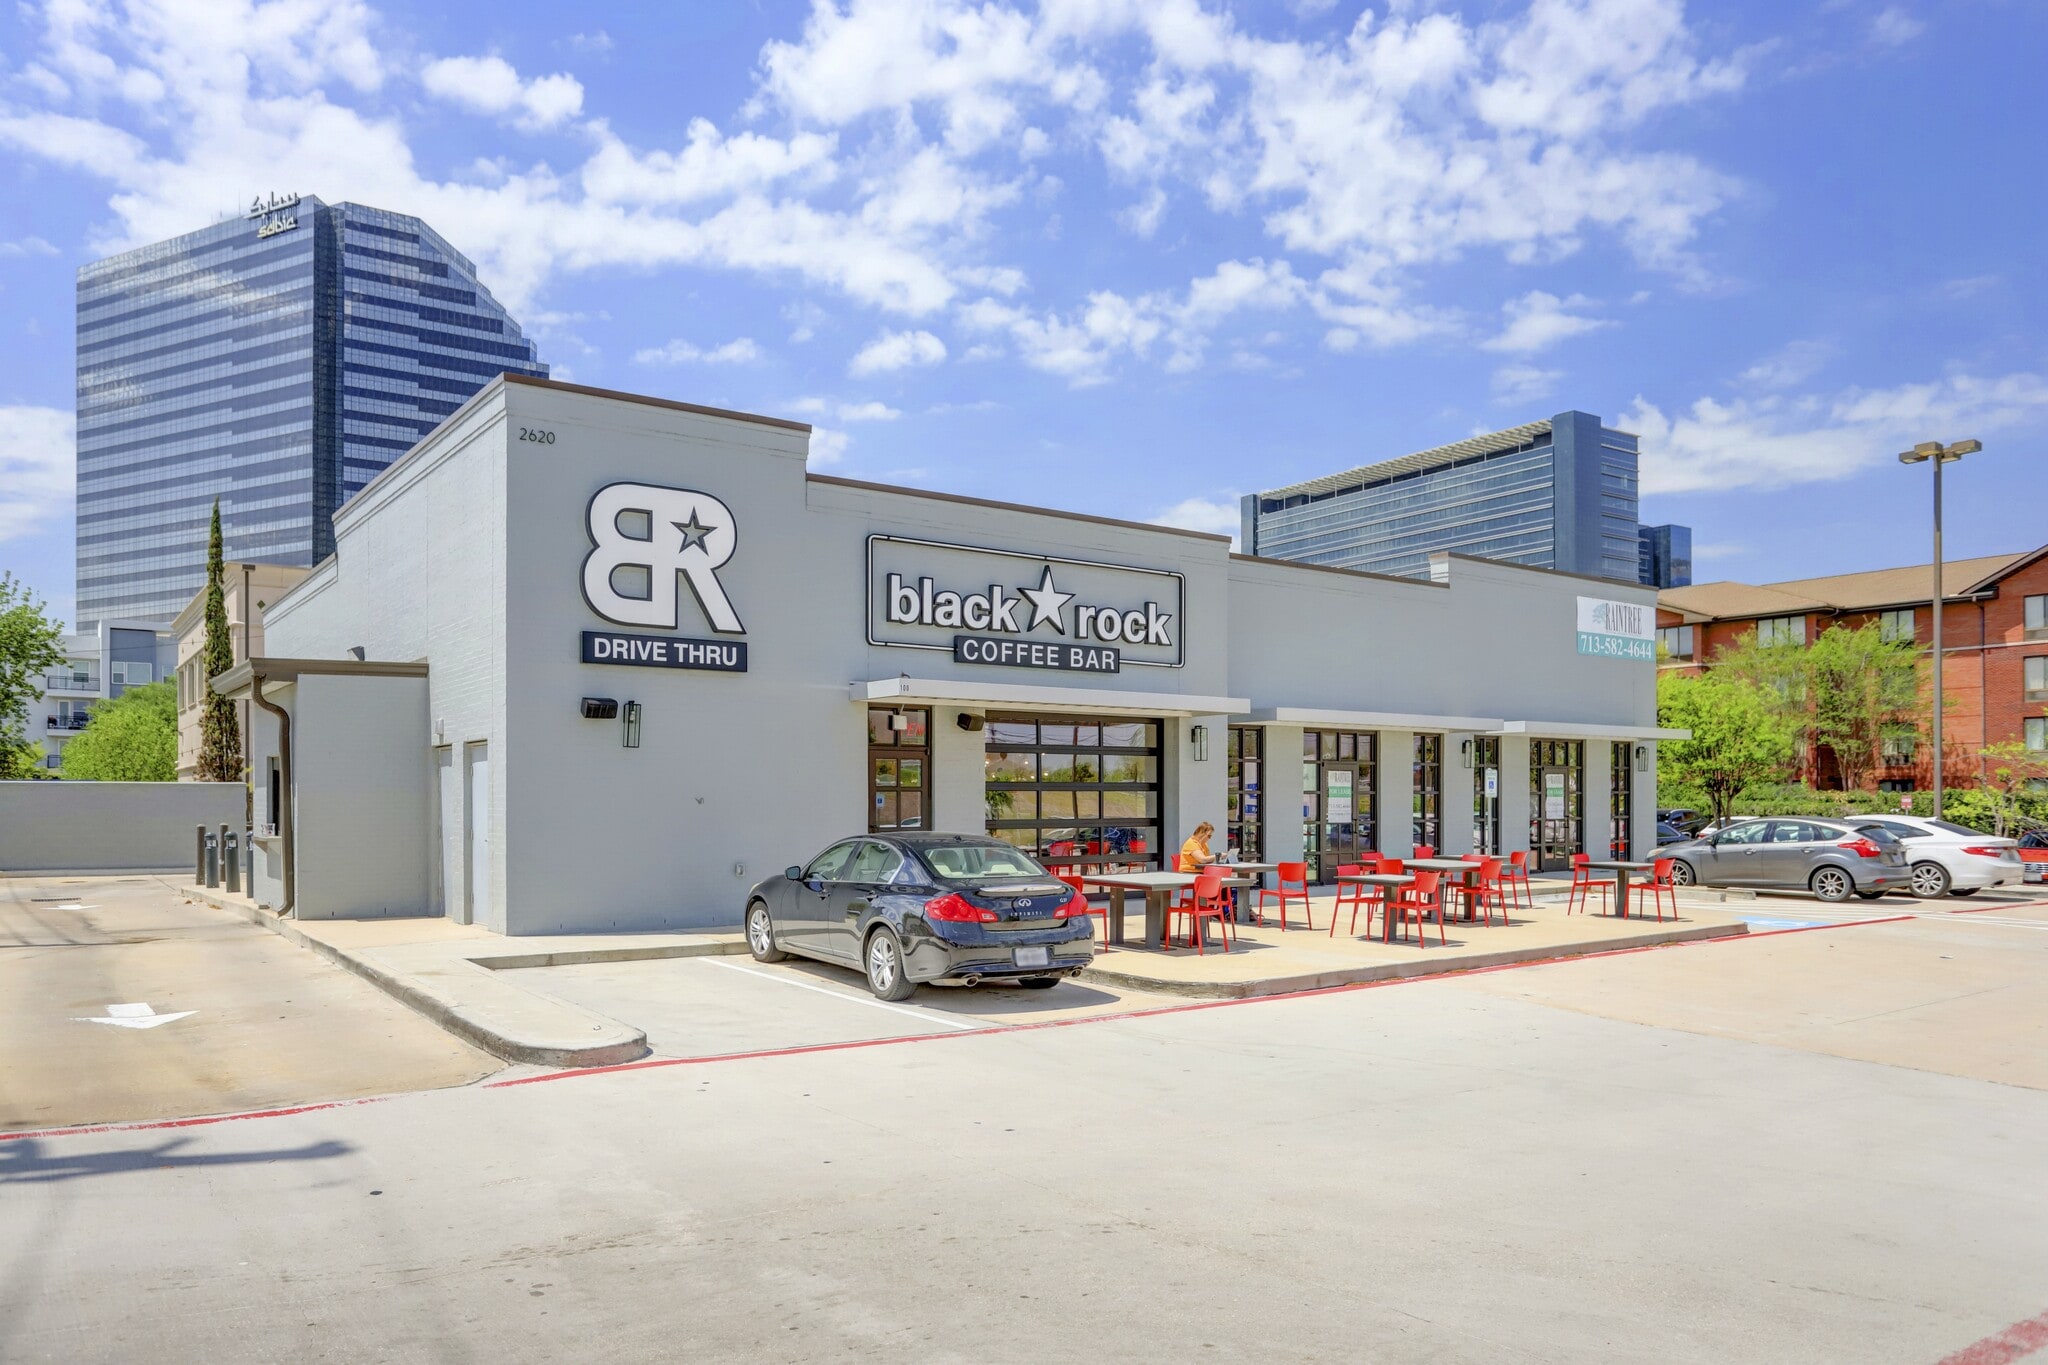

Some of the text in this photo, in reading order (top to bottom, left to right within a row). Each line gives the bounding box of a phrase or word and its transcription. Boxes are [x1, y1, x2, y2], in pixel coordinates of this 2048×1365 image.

[257, 214, 296, 237] sabic
[519, 427, 556, 445] 2620
[887, 573, 1172, 646] black rock
[1605, 603, 1642, 634] RAINTREE
[594, 637, 738, 666] DRIVE THRU
[962, 639, 1116, 671] COFFEE BAR
[1580, 634, 1652, 659] 713-582-4644
